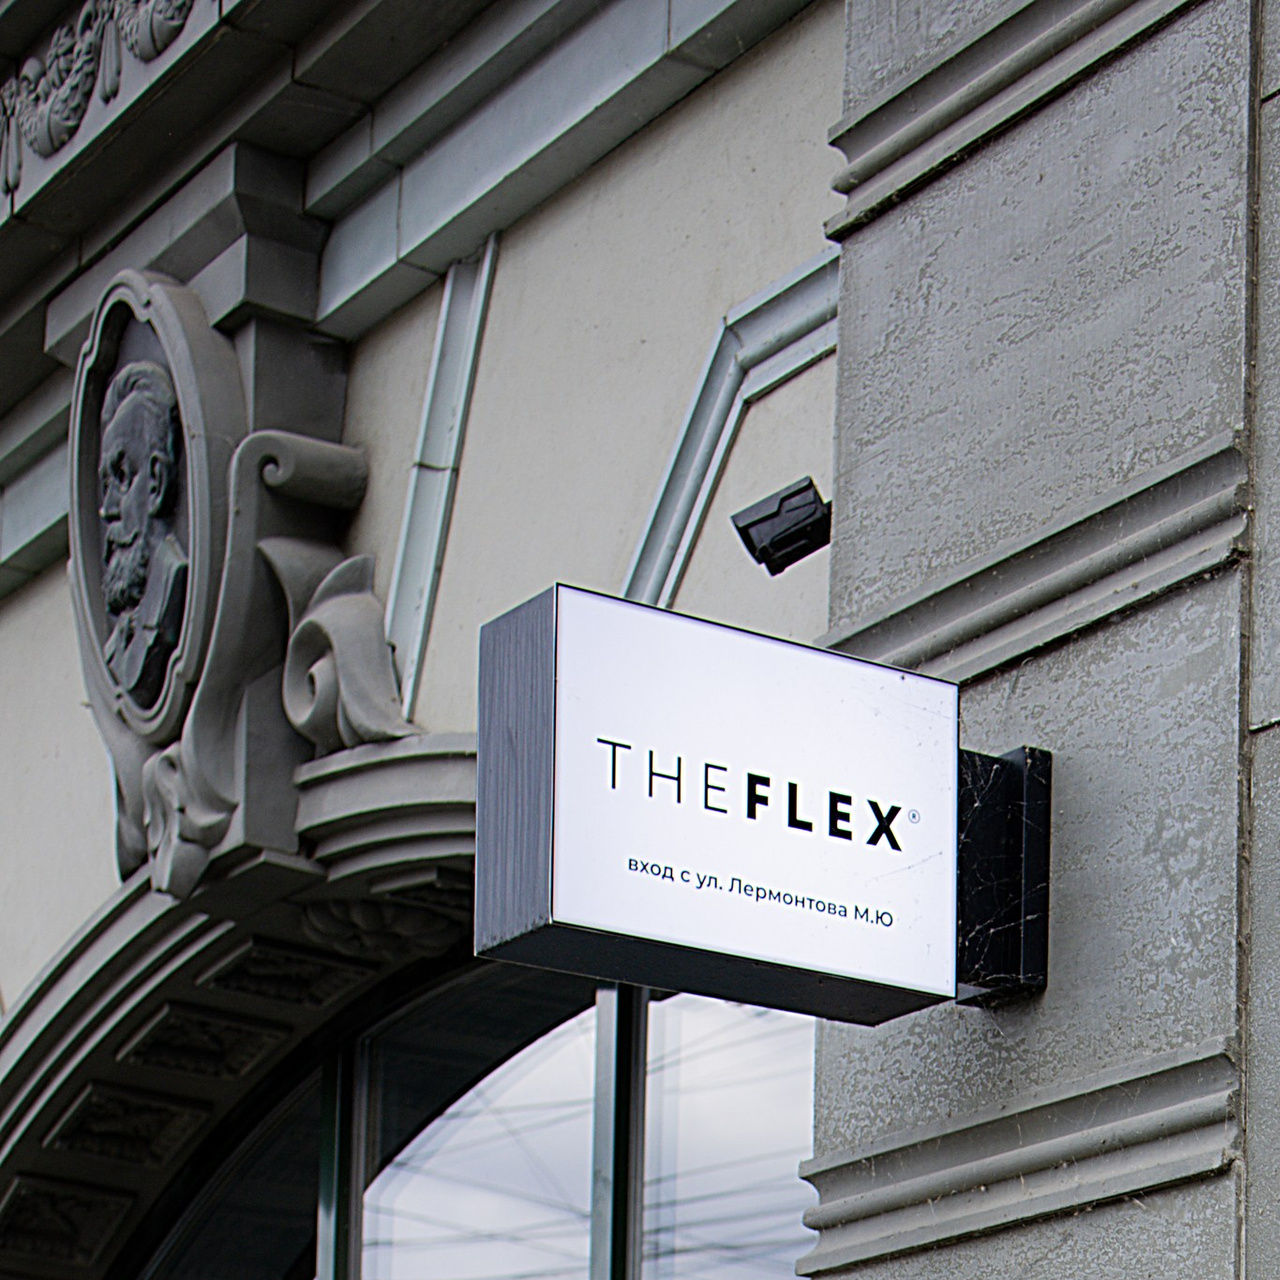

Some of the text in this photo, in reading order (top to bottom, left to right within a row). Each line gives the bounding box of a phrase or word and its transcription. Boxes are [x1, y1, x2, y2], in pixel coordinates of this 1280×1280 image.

[628, 858, 894, 928] вход с ул. Лермонтова М.Ю
